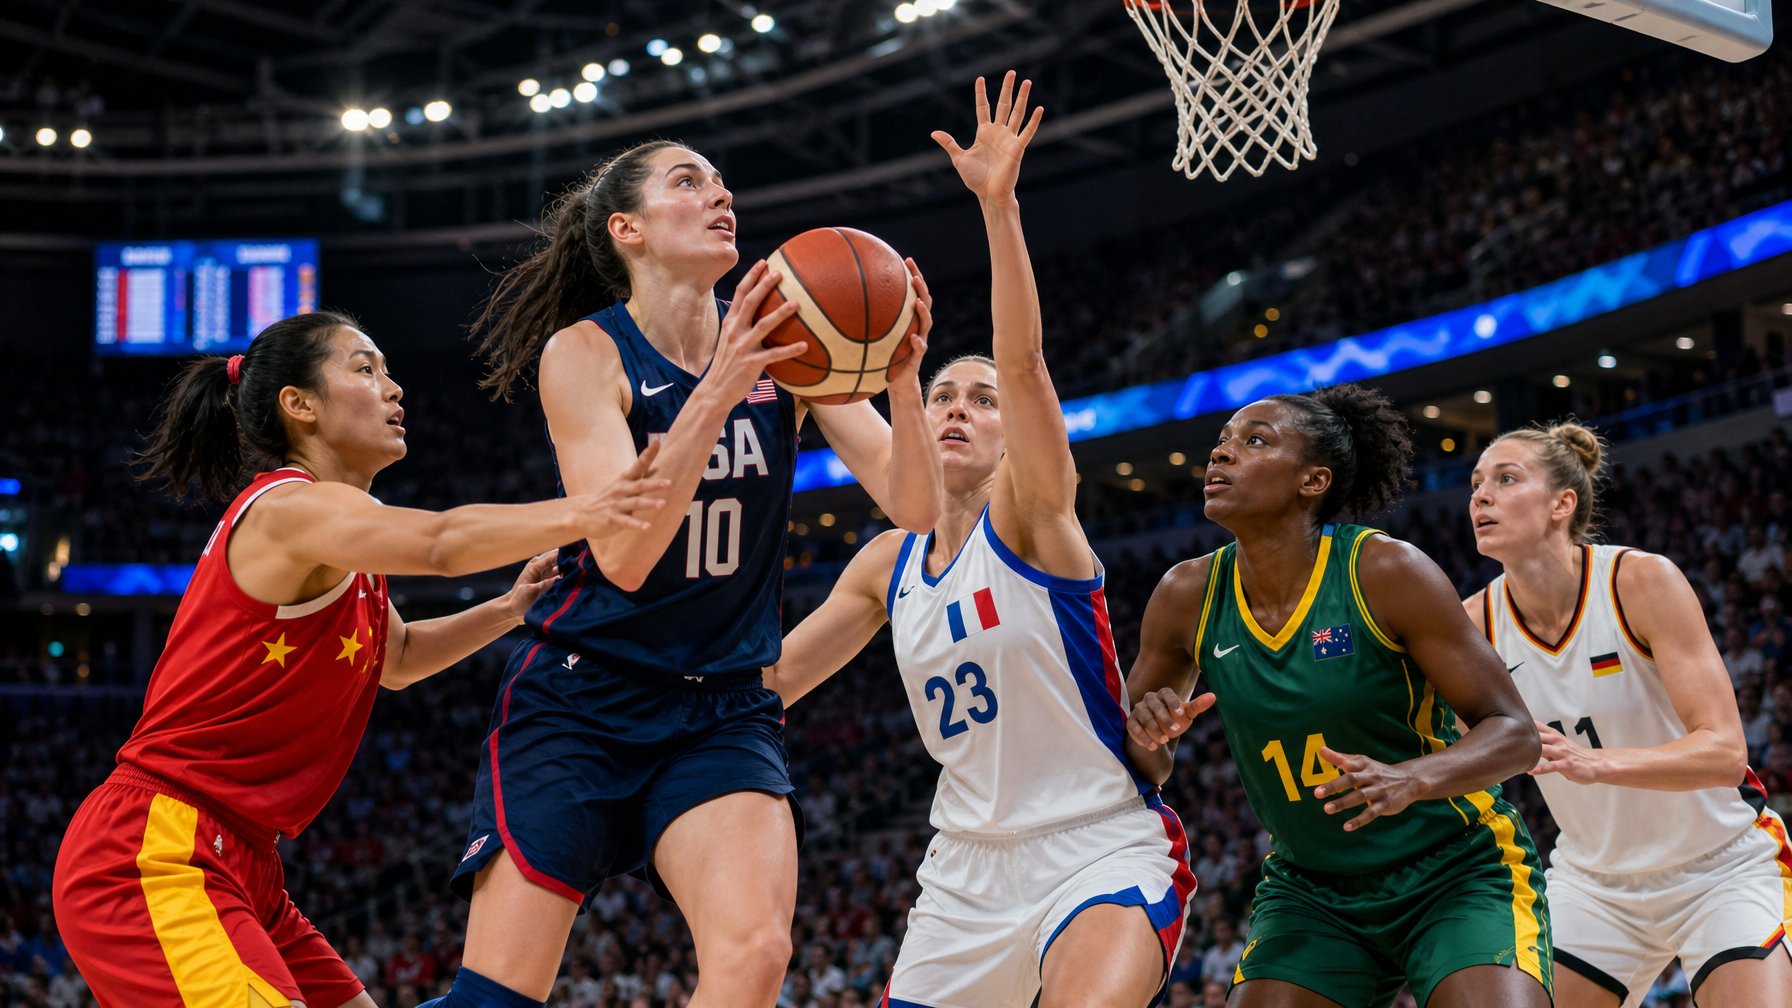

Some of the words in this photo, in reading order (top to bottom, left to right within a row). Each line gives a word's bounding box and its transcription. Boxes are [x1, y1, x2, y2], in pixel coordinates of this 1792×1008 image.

[647, 418, 769, 481] SA
[685, 498, 742, 578] 10
[924, 661, 998, 740] 23
[1261, 732, 1342, 801] 14
